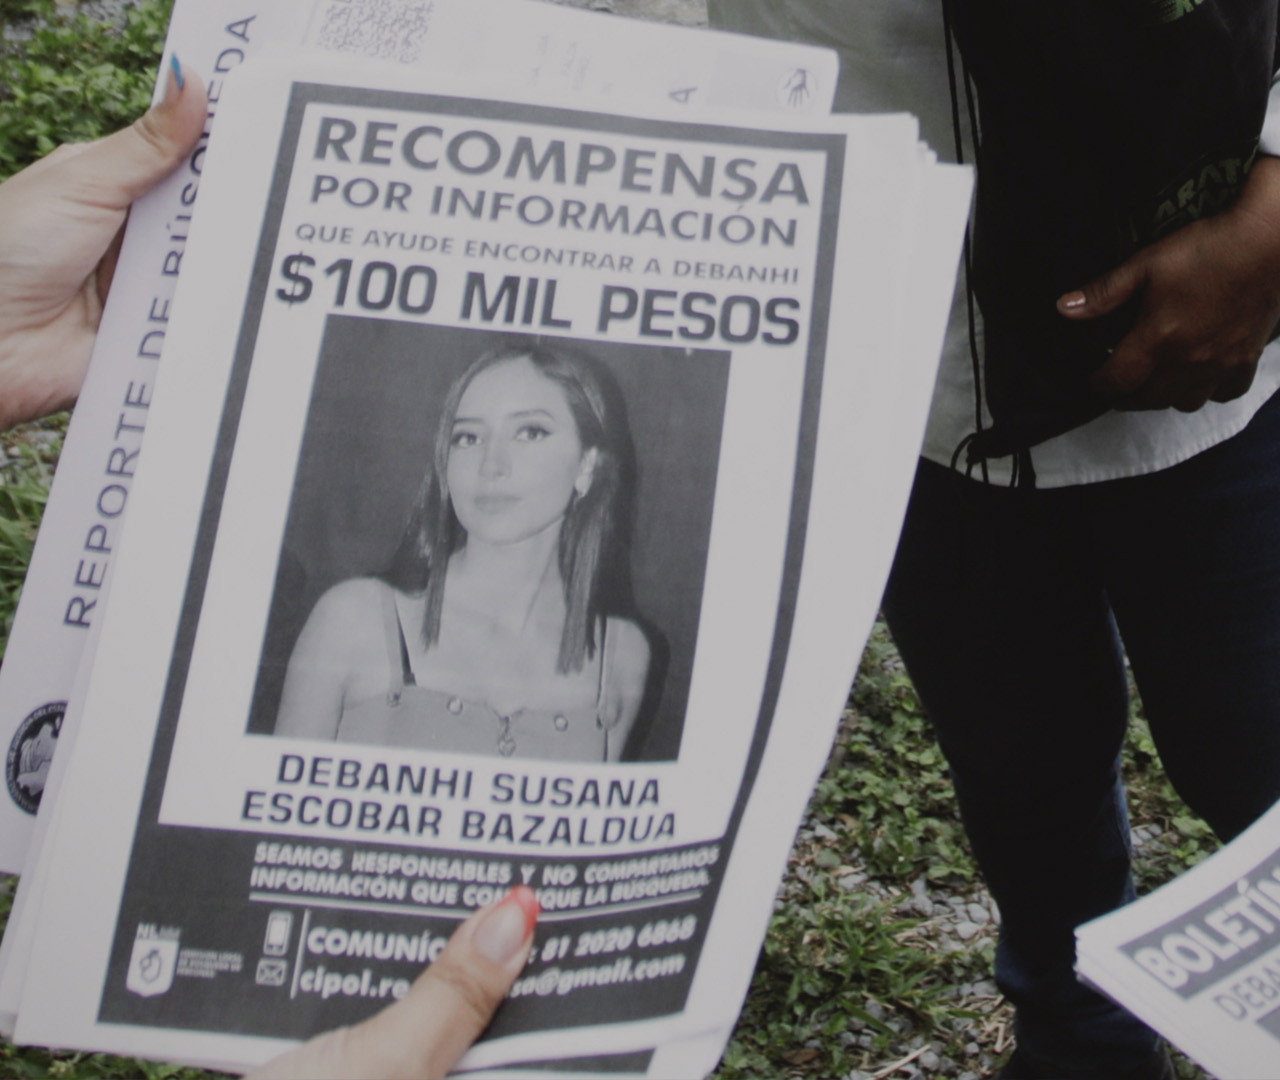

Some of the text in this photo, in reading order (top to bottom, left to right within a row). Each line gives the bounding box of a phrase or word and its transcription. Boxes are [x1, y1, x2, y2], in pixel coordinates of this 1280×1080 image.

[312, 117, 810, 206] RECOMPENSA
[310, 174, 798, 248] POR INFORMACIÓN
[295, 222, 799, 284] QUE AYUDE ENCONTRAR A DEBANHI
[276, 251, 802, 347] $100 MIL PESOS
[63, 381, 153, 629] REPORTE
[137, 297, 171, 358] DE
[276, 753, 662, 809] DEBANHI SUSANA
[241, 790, 678, 847] ESCOBAR BAZALDUA
[249, 866, 405, 901] INFORMACIÓN
[411, 883, 459, 908] QUE
[584, 885, 607, 906] LA
[253, 842, 720, 887] SEAMOS RESPONSABLES Y NO COMPARTAMOS
[541, 935, 571, 962] 81
[575, 924, 635, 957] 2020
